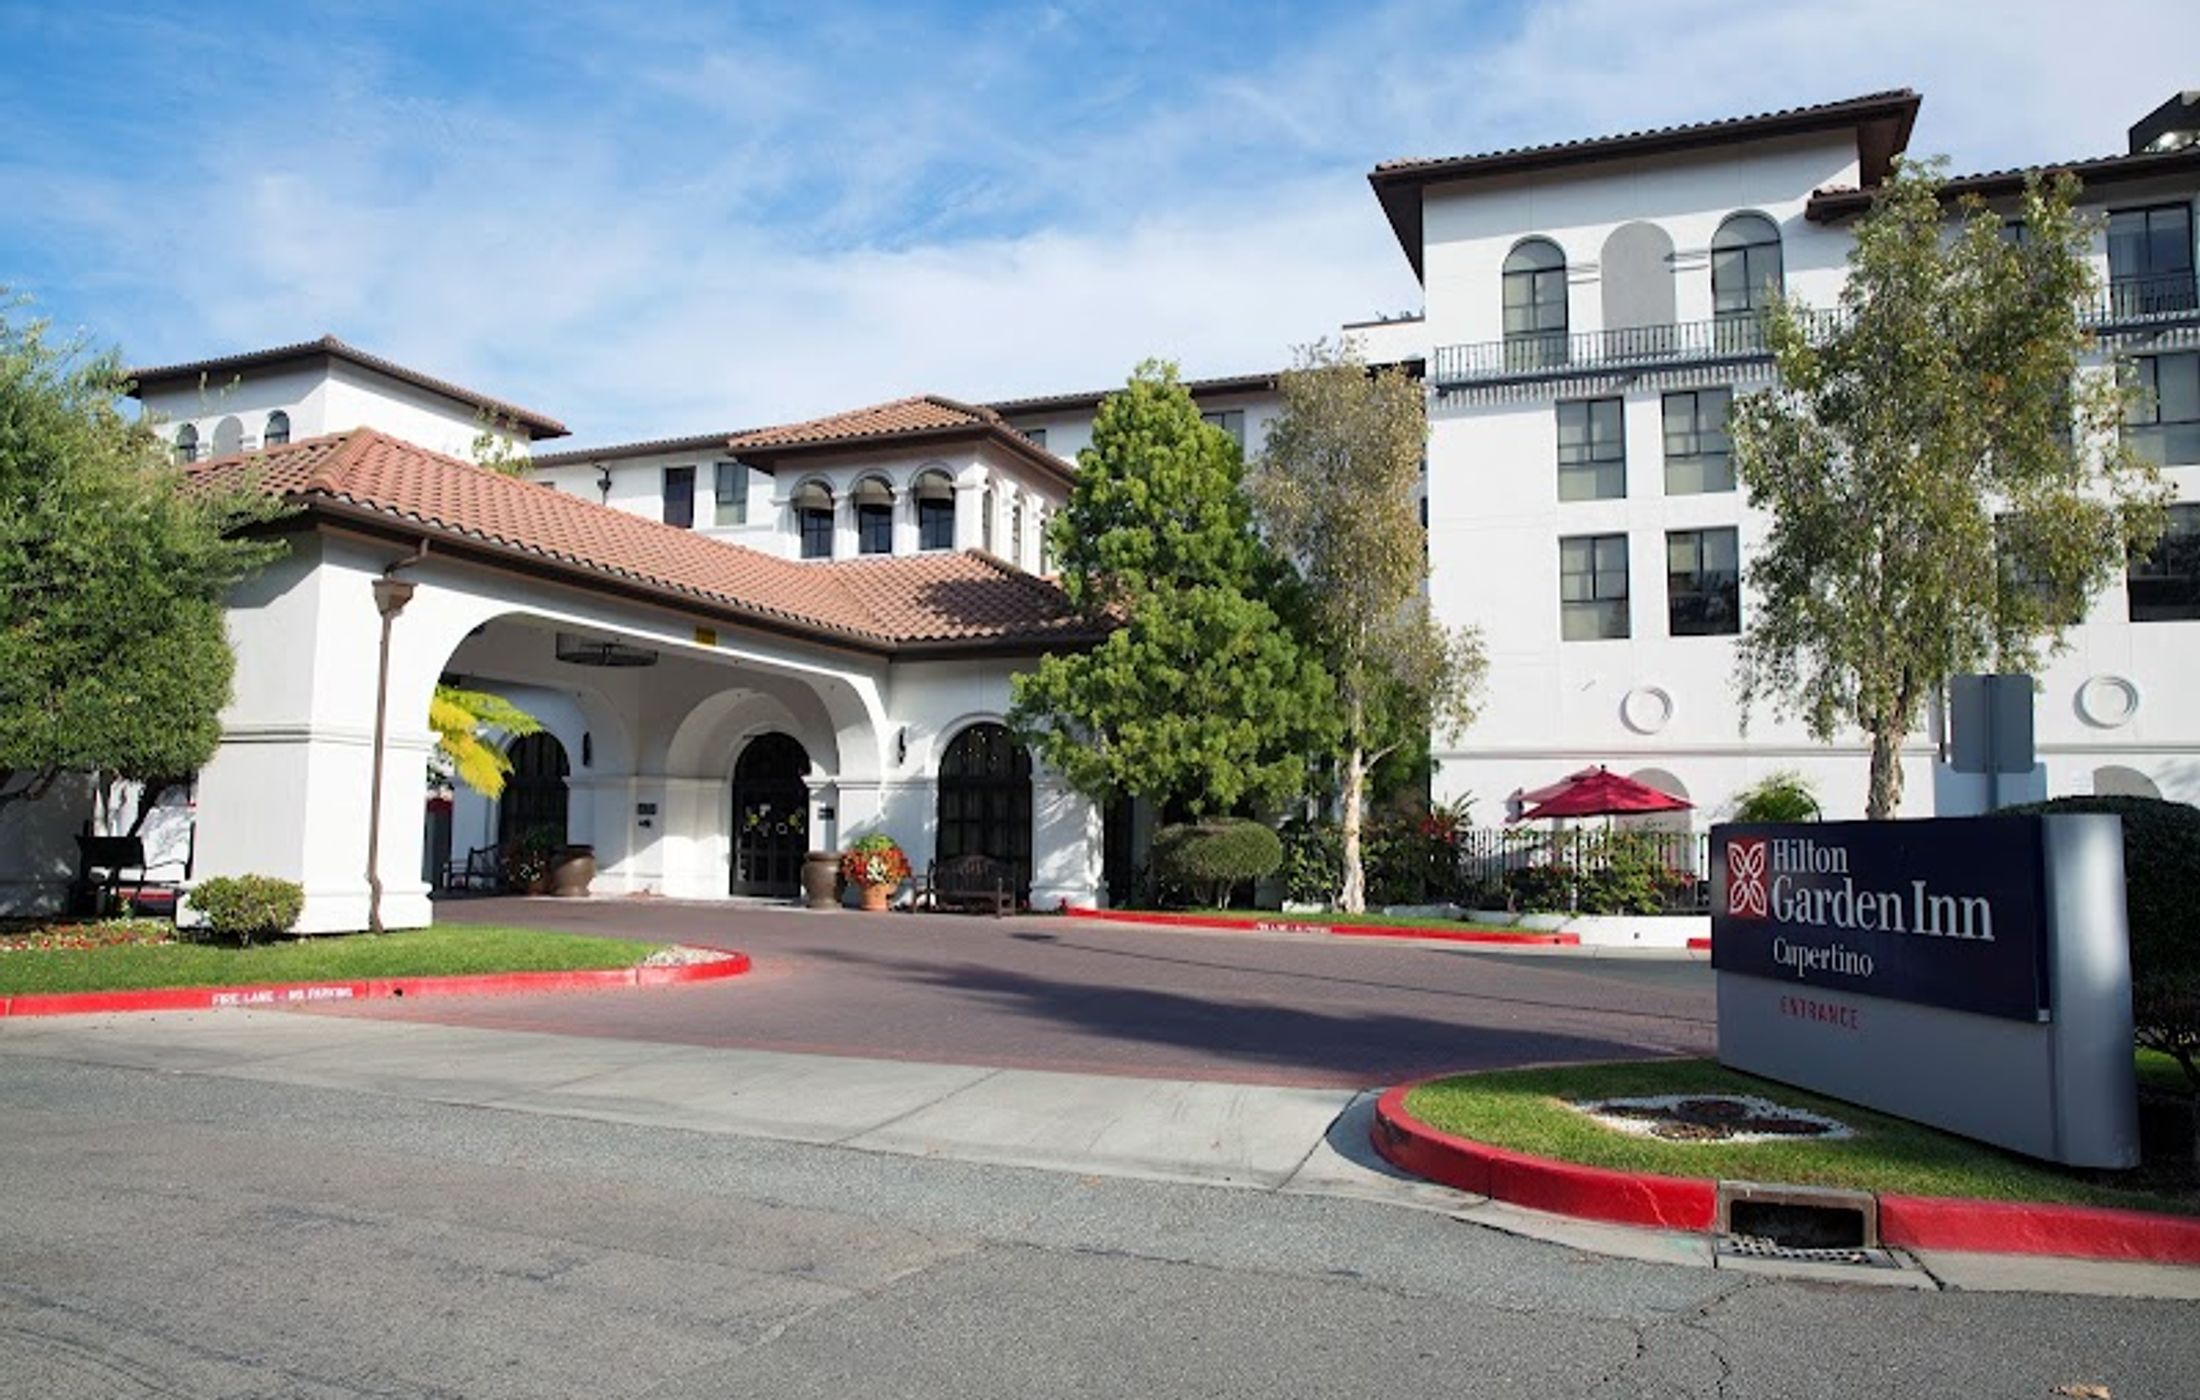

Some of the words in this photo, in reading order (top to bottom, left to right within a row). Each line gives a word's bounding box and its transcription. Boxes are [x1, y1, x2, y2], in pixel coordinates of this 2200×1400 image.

[1772, 838, 1849, 873] Hilton
[1771, 874, 1907, 933] Garden
[1911, 880, 1996, 942] Inn
[1773, 936, 1875, 978] Cupertino
[244, 990, 274, 1003] LANE
[288, 989, 304, 1001] NO
[1781, 995, 1859, 1031] ENTRANCE
